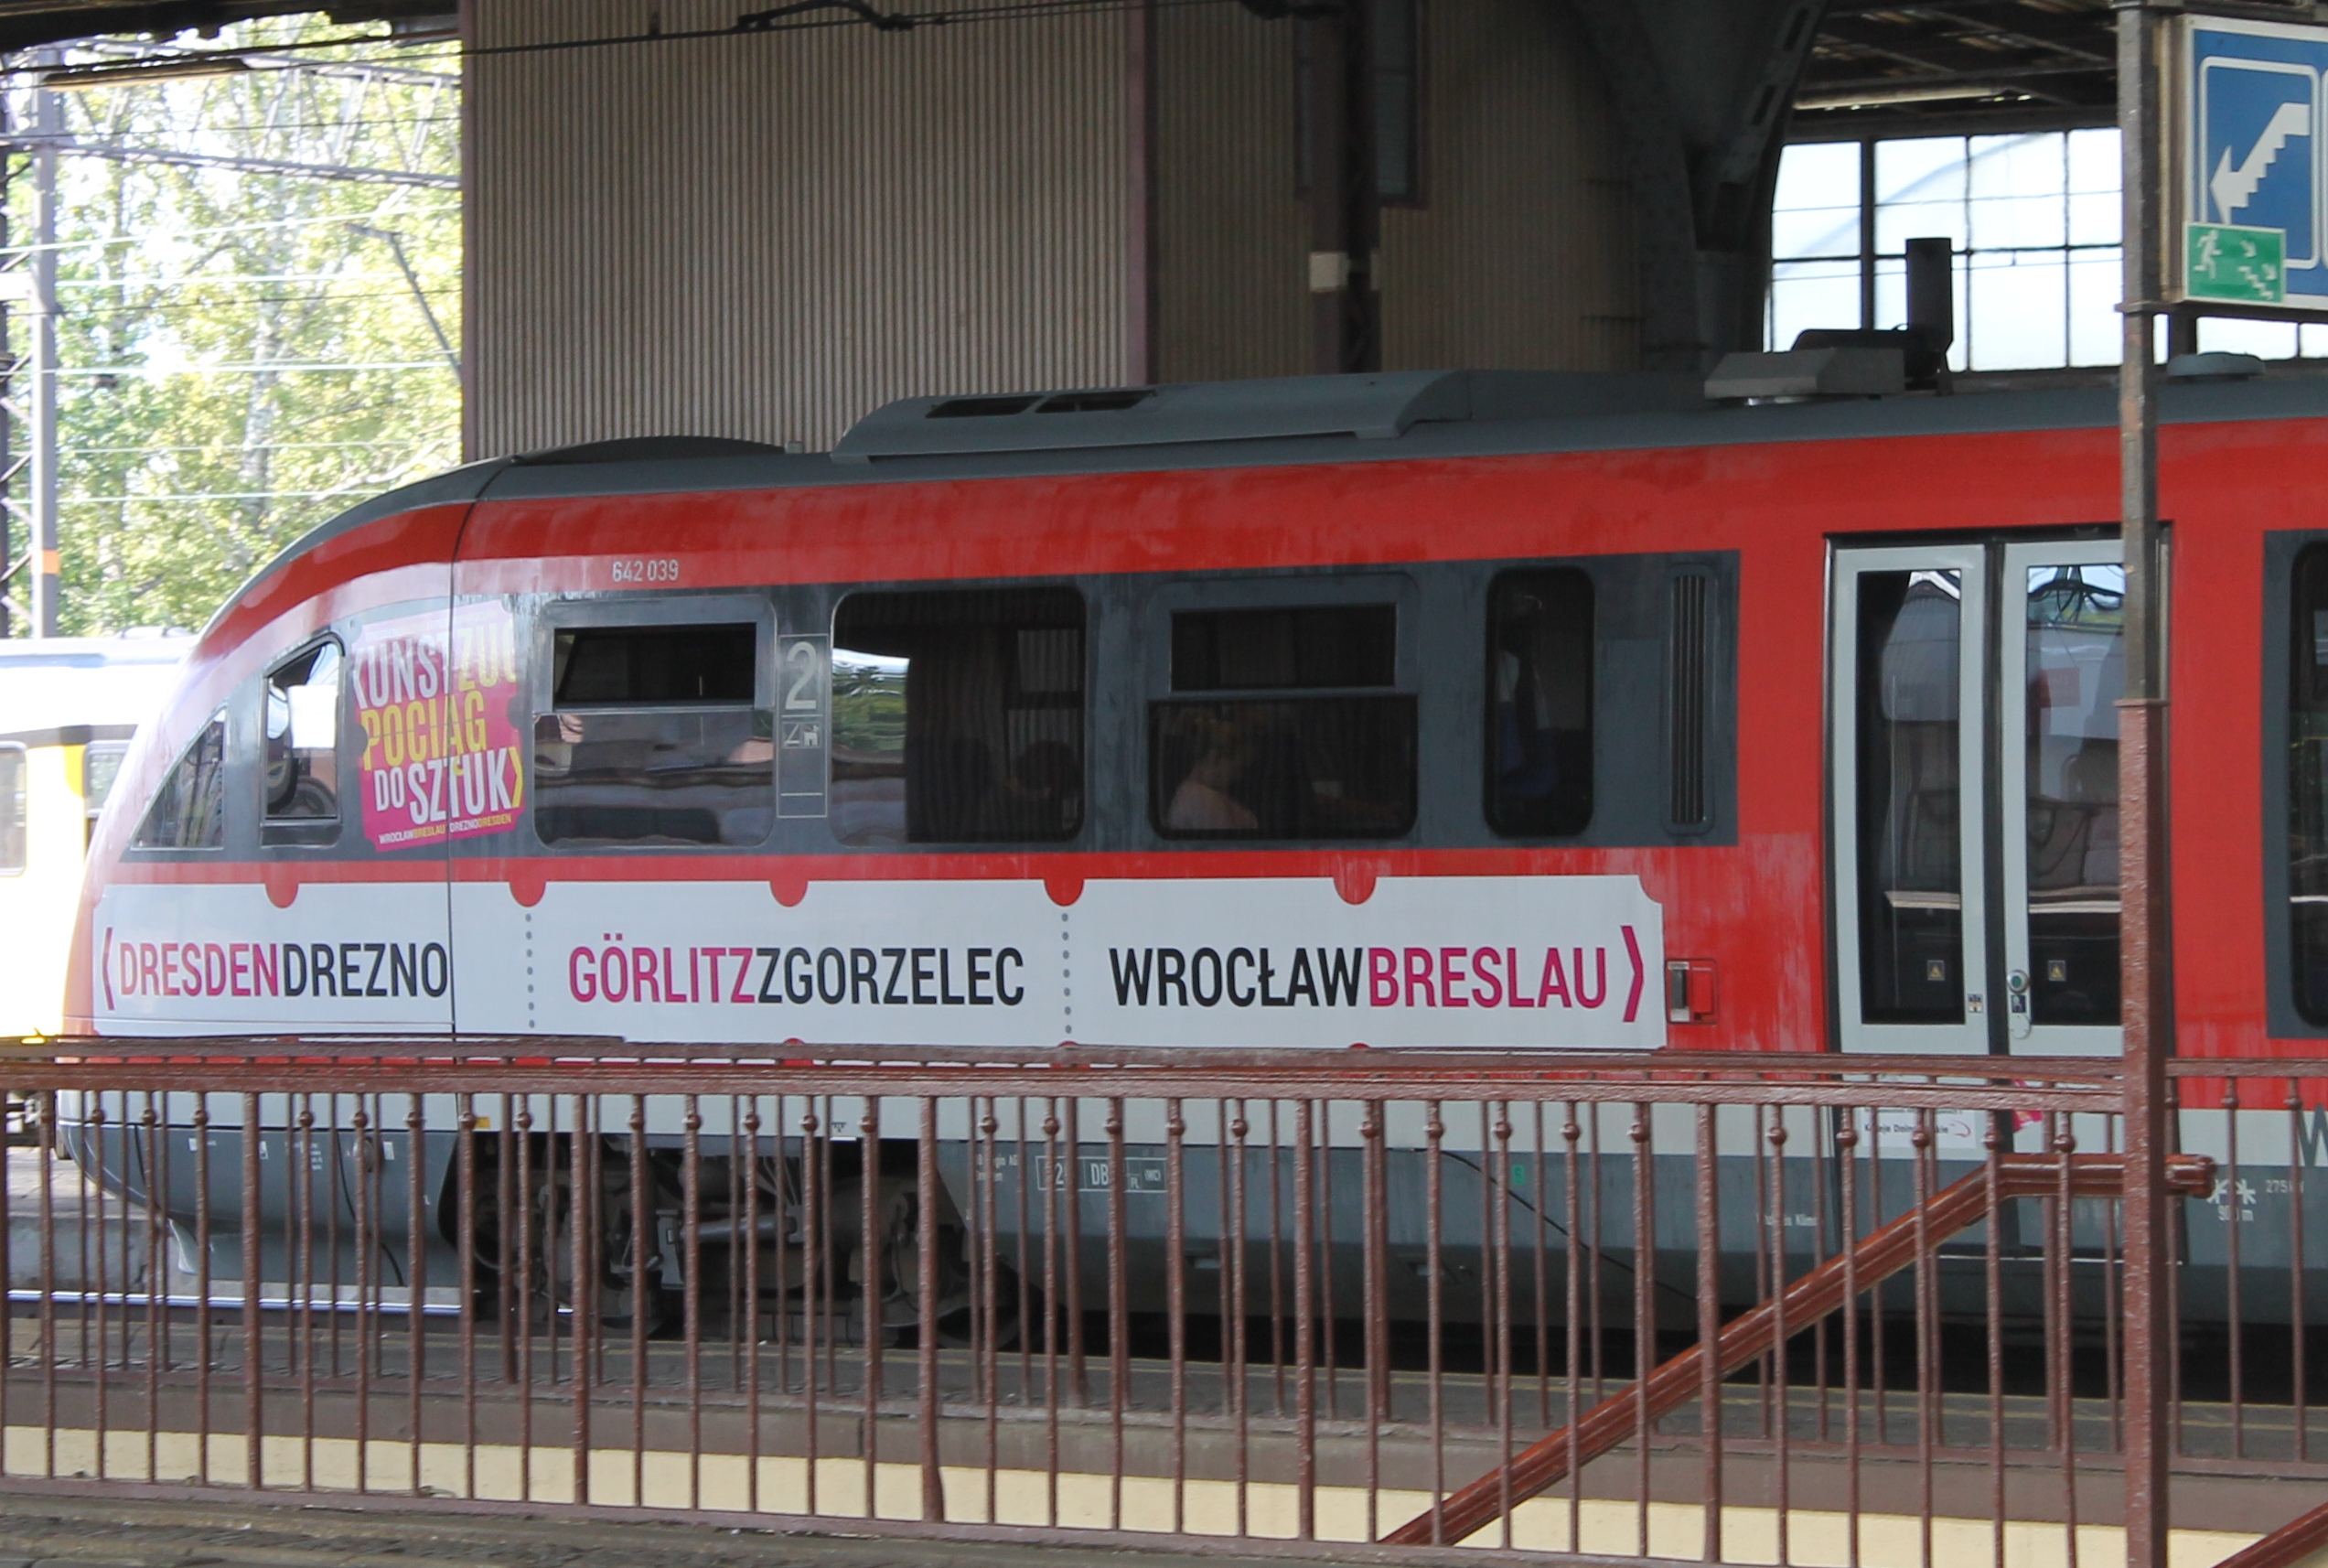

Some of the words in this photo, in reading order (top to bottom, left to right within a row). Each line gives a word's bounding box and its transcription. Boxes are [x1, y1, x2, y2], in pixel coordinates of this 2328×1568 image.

[612, 560, 642, 582] 642
[647, 559, 679, 582] 039
[785, 641, 817, 710] 2
[360, 690, 487, 776] POCIĄG
[120, 942, 447, 997] DRESDENDREZNO
[569, 932, 1025, 1005] GÖRLITZZGORZELEC
[1109, 947, 1606, 1008] WROCŁAWBRESLAU
